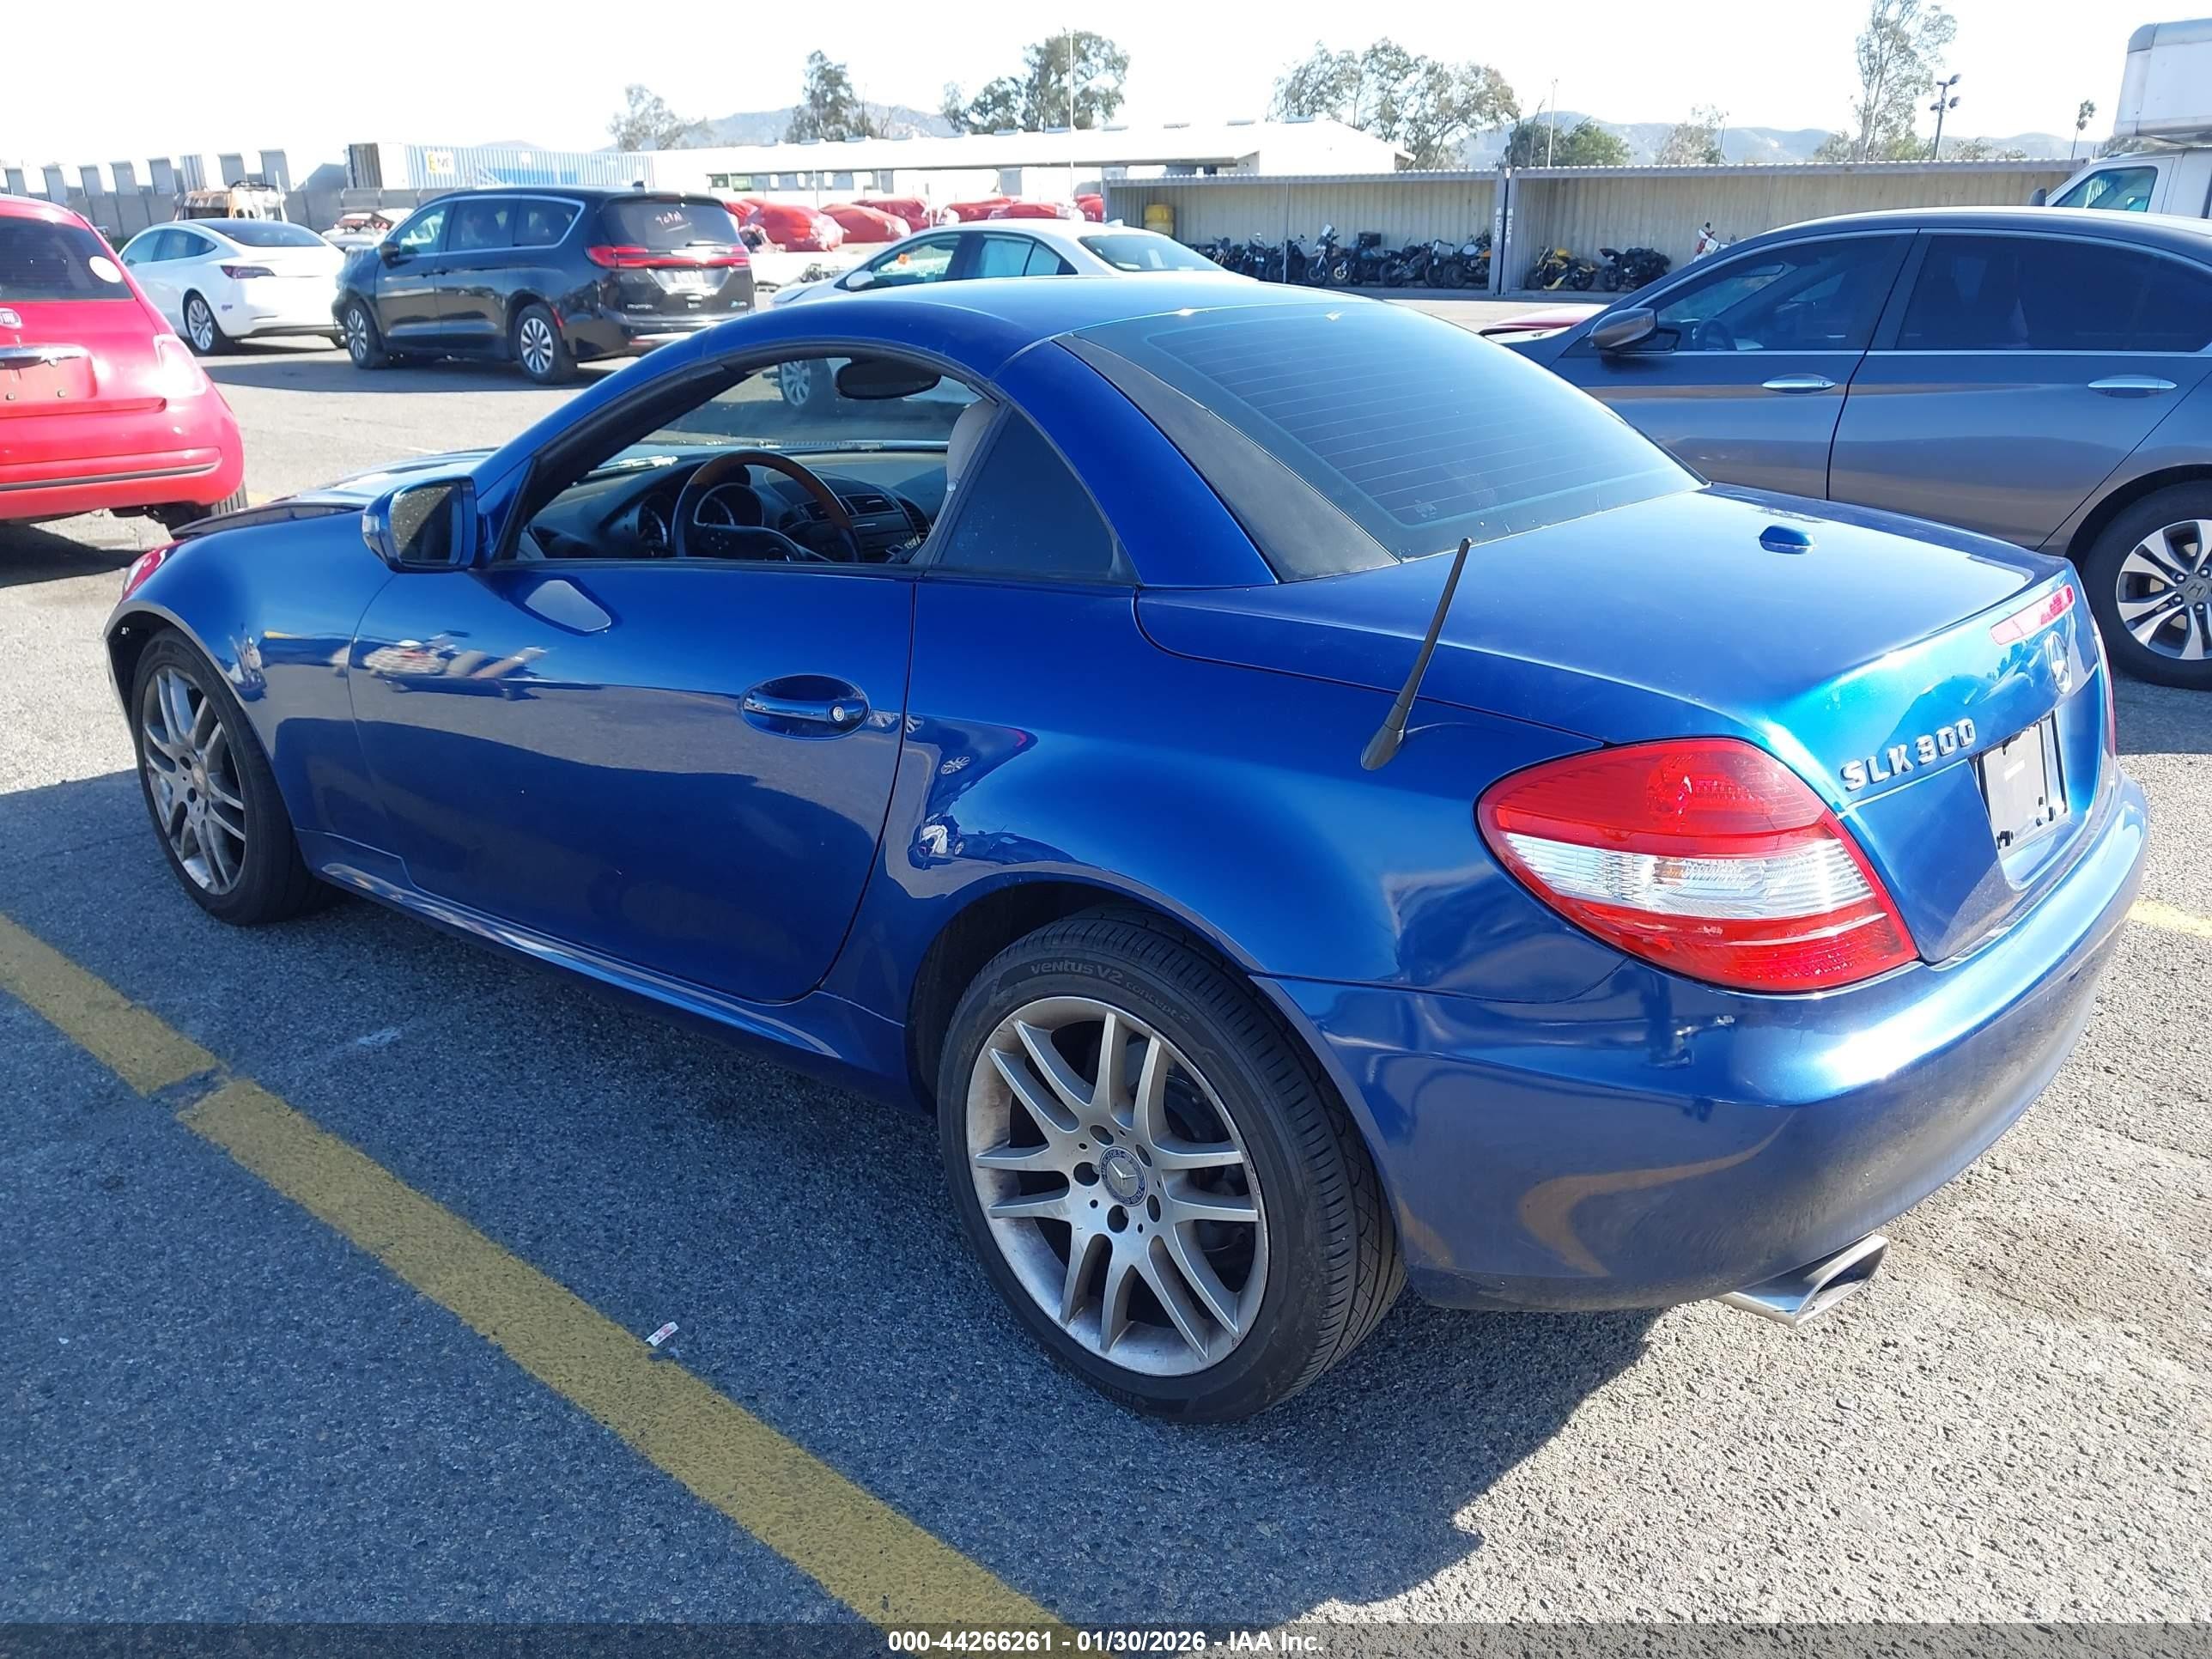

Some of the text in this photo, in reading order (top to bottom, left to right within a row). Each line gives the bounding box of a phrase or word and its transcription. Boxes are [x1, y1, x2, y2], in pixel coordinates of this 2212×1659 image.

[1841, 718, 1977, 792] SLK 300
[1097, 964, 1123, 984] V2
[1180, 1013, 1191, 1024] 2
[1131, 1188, 1144, 1202] BENZ
